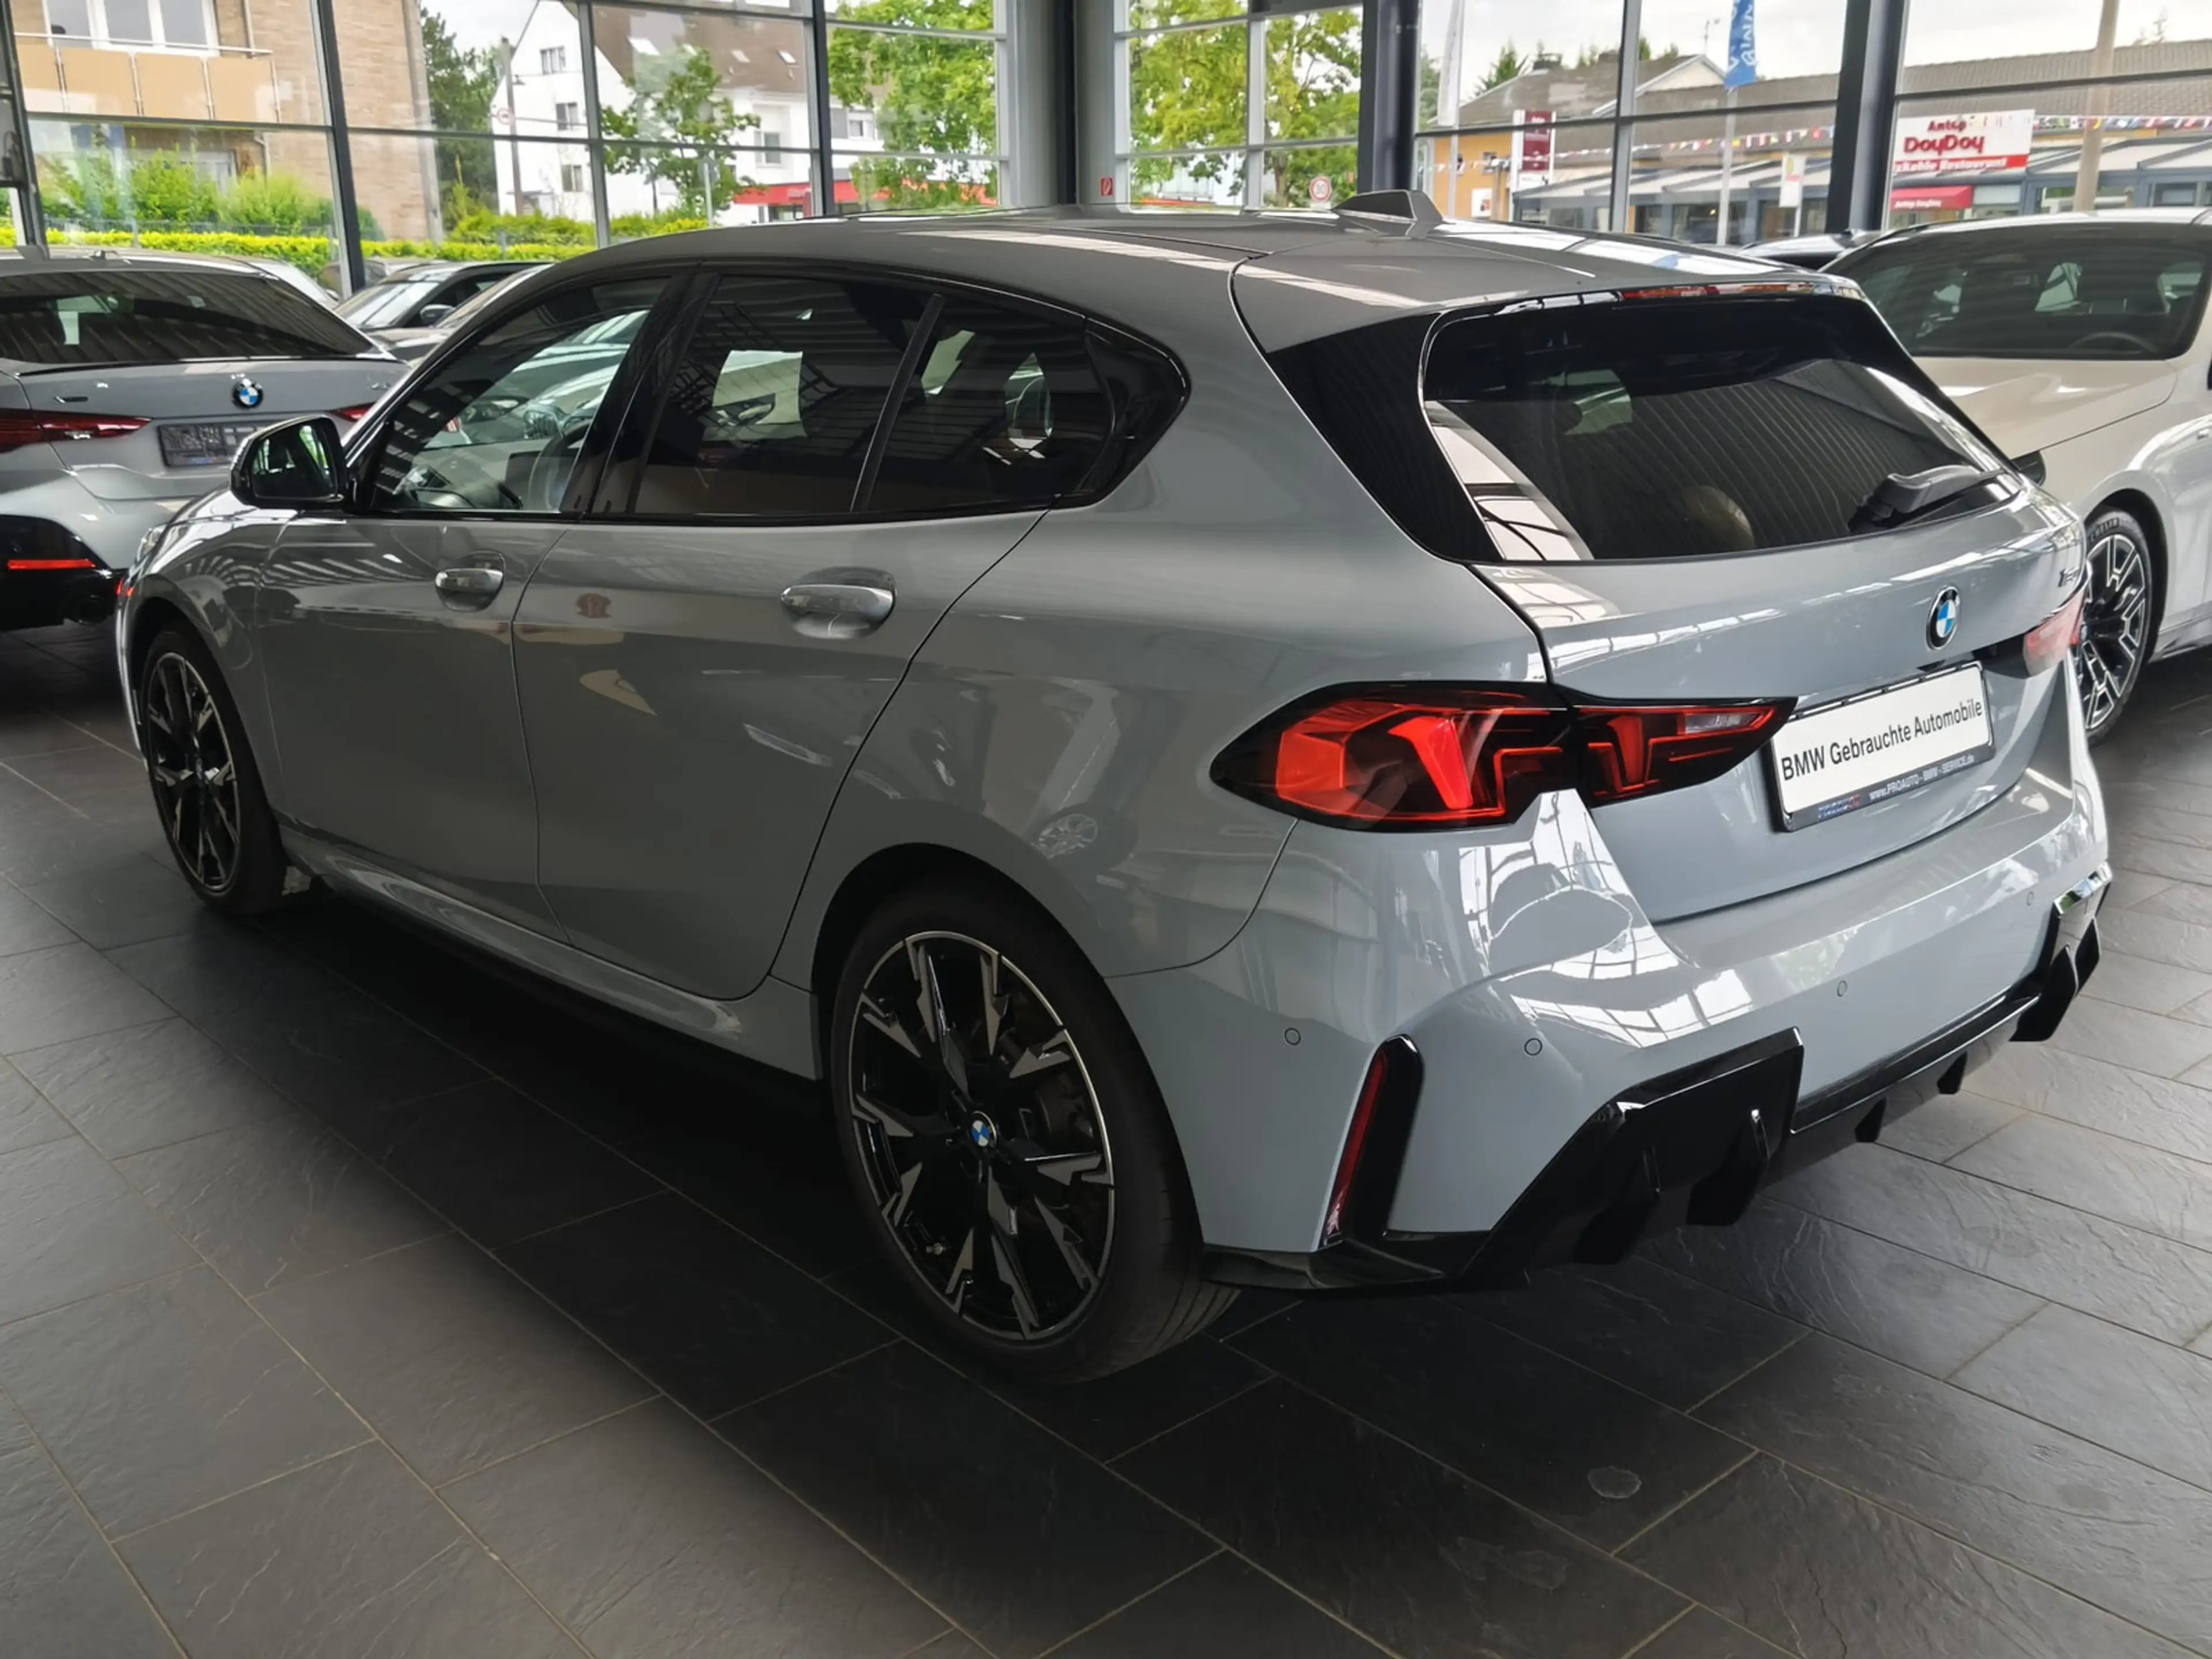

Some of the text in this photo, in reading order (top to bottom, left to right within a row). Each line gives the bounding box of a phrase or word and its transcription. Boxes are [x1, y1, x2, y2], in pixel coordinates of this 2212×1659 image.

[1903, 134, 1985, 156] DoyDoy
[1781, 698, 1982, 781] BMW Gebrauchte Automobile
